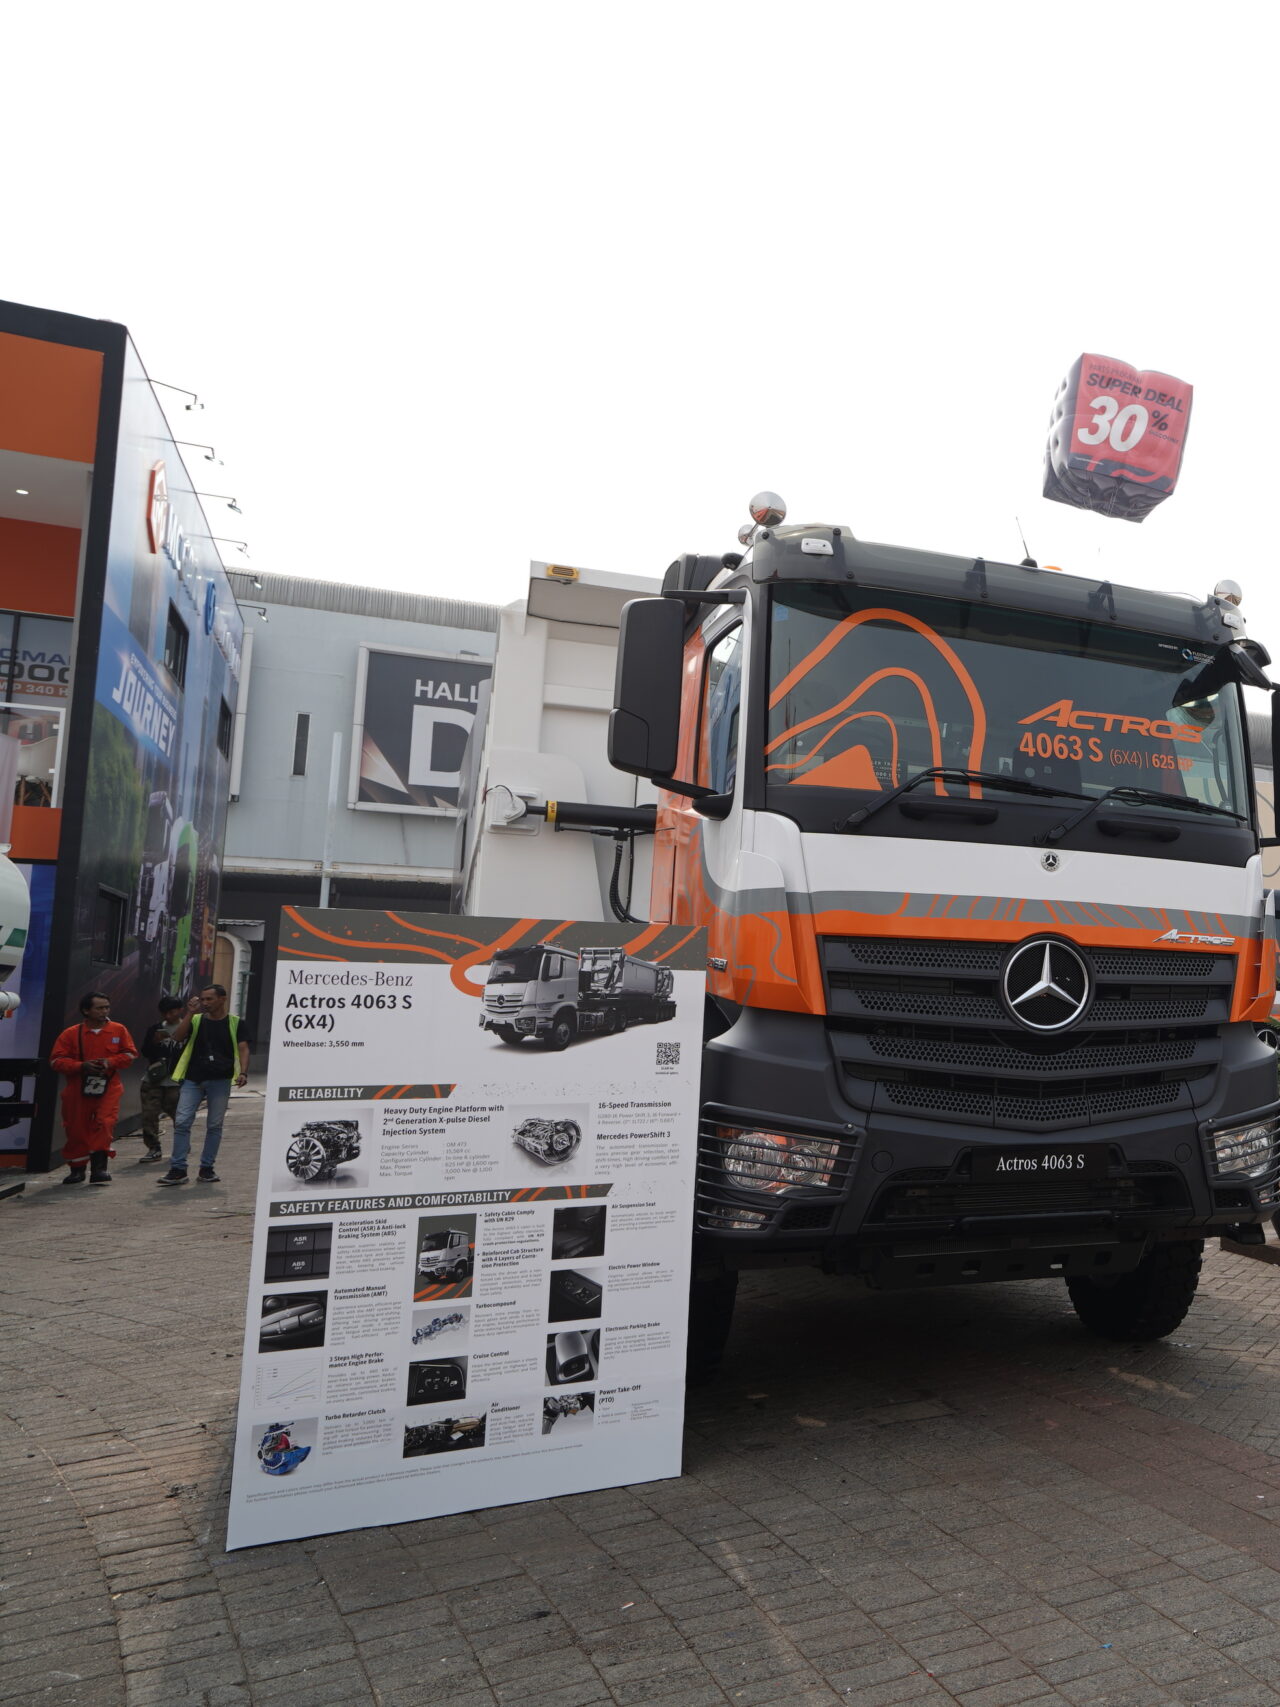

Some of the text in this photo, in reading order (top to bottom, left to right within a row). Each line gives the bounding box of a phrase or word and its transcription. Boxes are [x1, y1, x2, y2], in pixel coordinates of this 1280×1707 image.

[1086, 373, 1184, 413] SUPER DEAL
[26, 684, 55, 695] 340
[414, 678, 479, 704] HALL
[111, 663, 176, 759] JOURNEY
[1016, 699, 1205, 744] ACTROS
[408, 704, 478, 789] D
[1019, 731, 1195, 772] 4063 S (6X4) 625 HP
[1152, 929, 1236, 946] ACTROS
[288, 970, 413, 987] Mercedes-Benz
[286, 993, 412, 1010] Actros 4063 S
[284, 1013, 335, 1033] (6X4)
[283, 1040, 327, 1048] Wheelbase:
[328, 1040, 350, 1049] 3,550
[288, 1088, 364, 1099] RELIABILITY
[383, 1104, 504, 1116] Heavy Duty Engine Platform with
[598, 1100, 672, 1110] 16-Speed Transmission
[395, 1117, 437, 1125] Generation
[438, 1116, 466, 1125] X-pulse
[467, 1115, 491, 1123] Diesel
[382, 1128, 446, 1137] Injection System
[630, 1131, 663, 1139] PowerShift
[996, 1154, 1085, 1171] Actros 4063 S
[279, 1191, 512, 1215] SAFETY FEATURES AND COMFORTABILITY
[599, 1388, 617, 1396] Power
